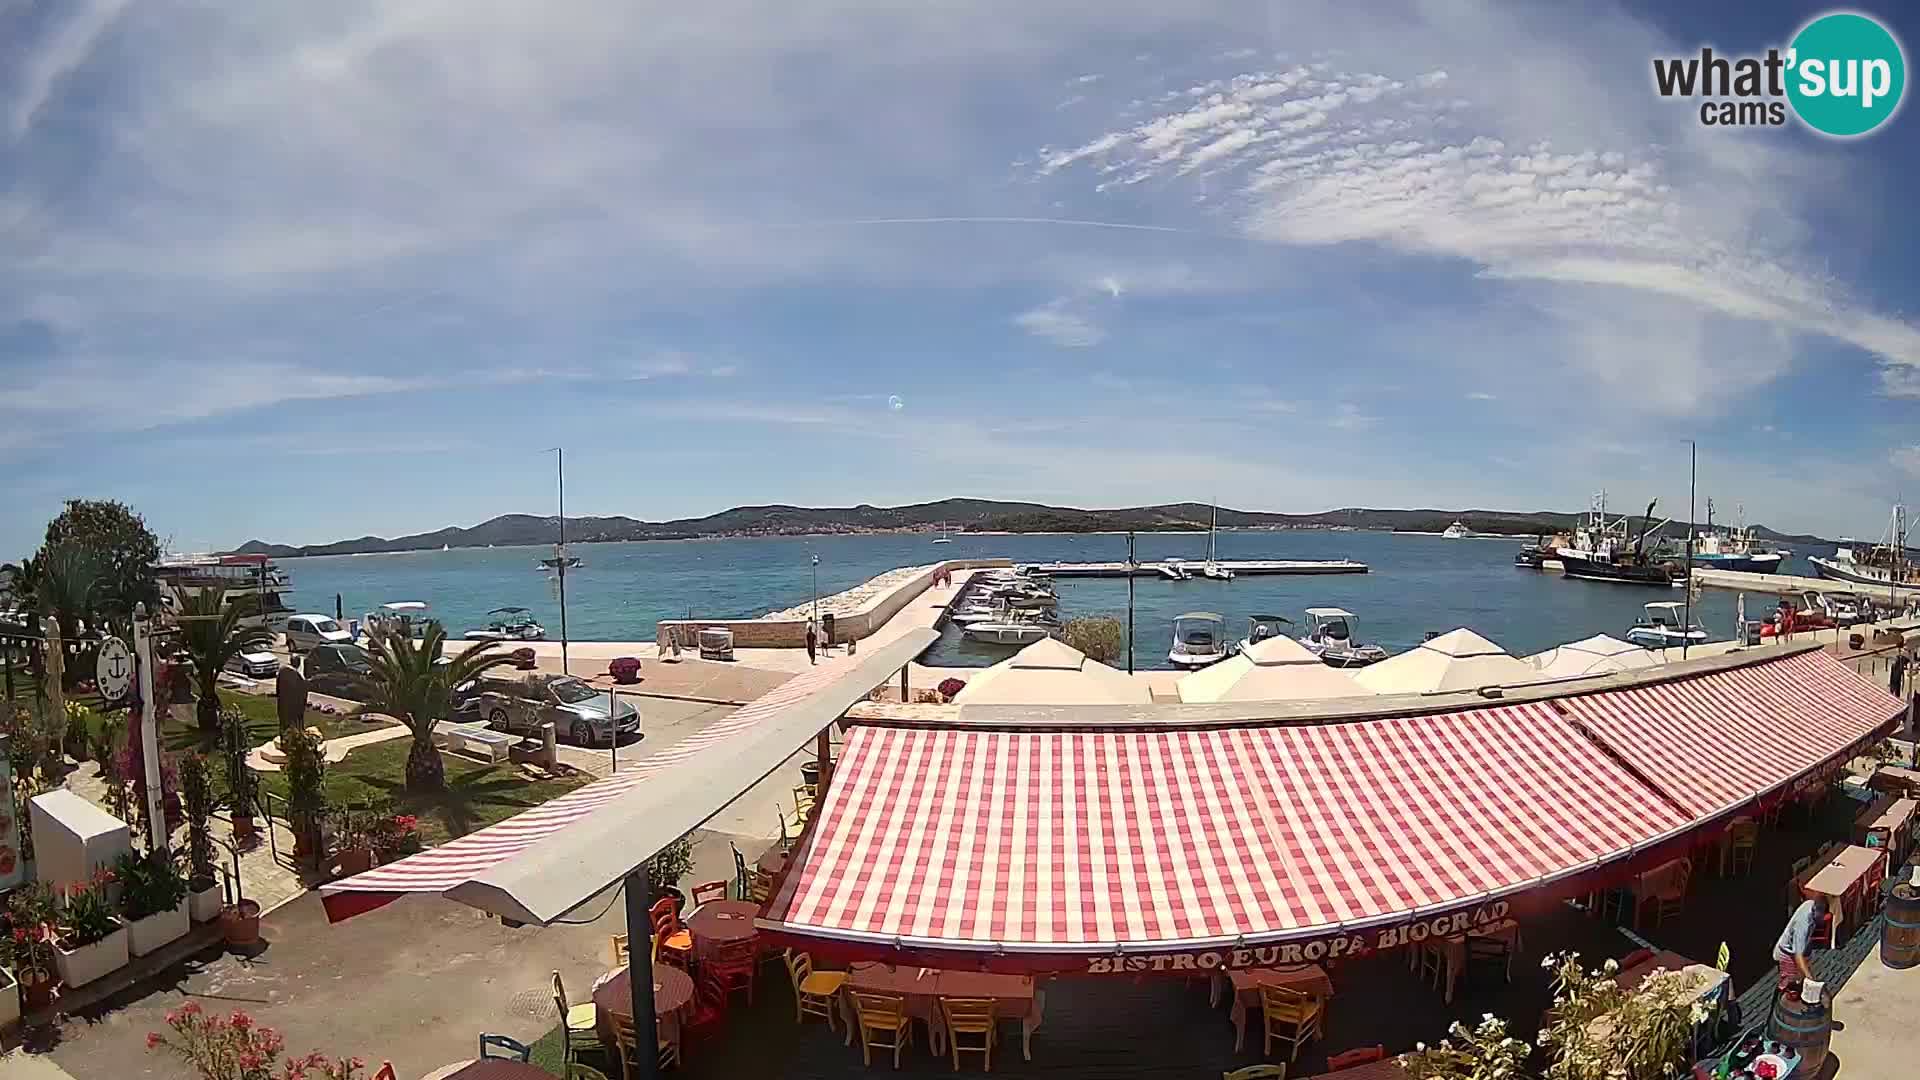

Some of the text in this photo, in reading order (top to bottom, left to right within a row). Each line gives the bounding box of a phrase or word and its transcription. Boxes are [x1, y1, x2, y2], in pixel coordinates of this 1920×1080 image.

[1087, 900, 1510, 973] BISTRO EUROPA BIOGRAD
